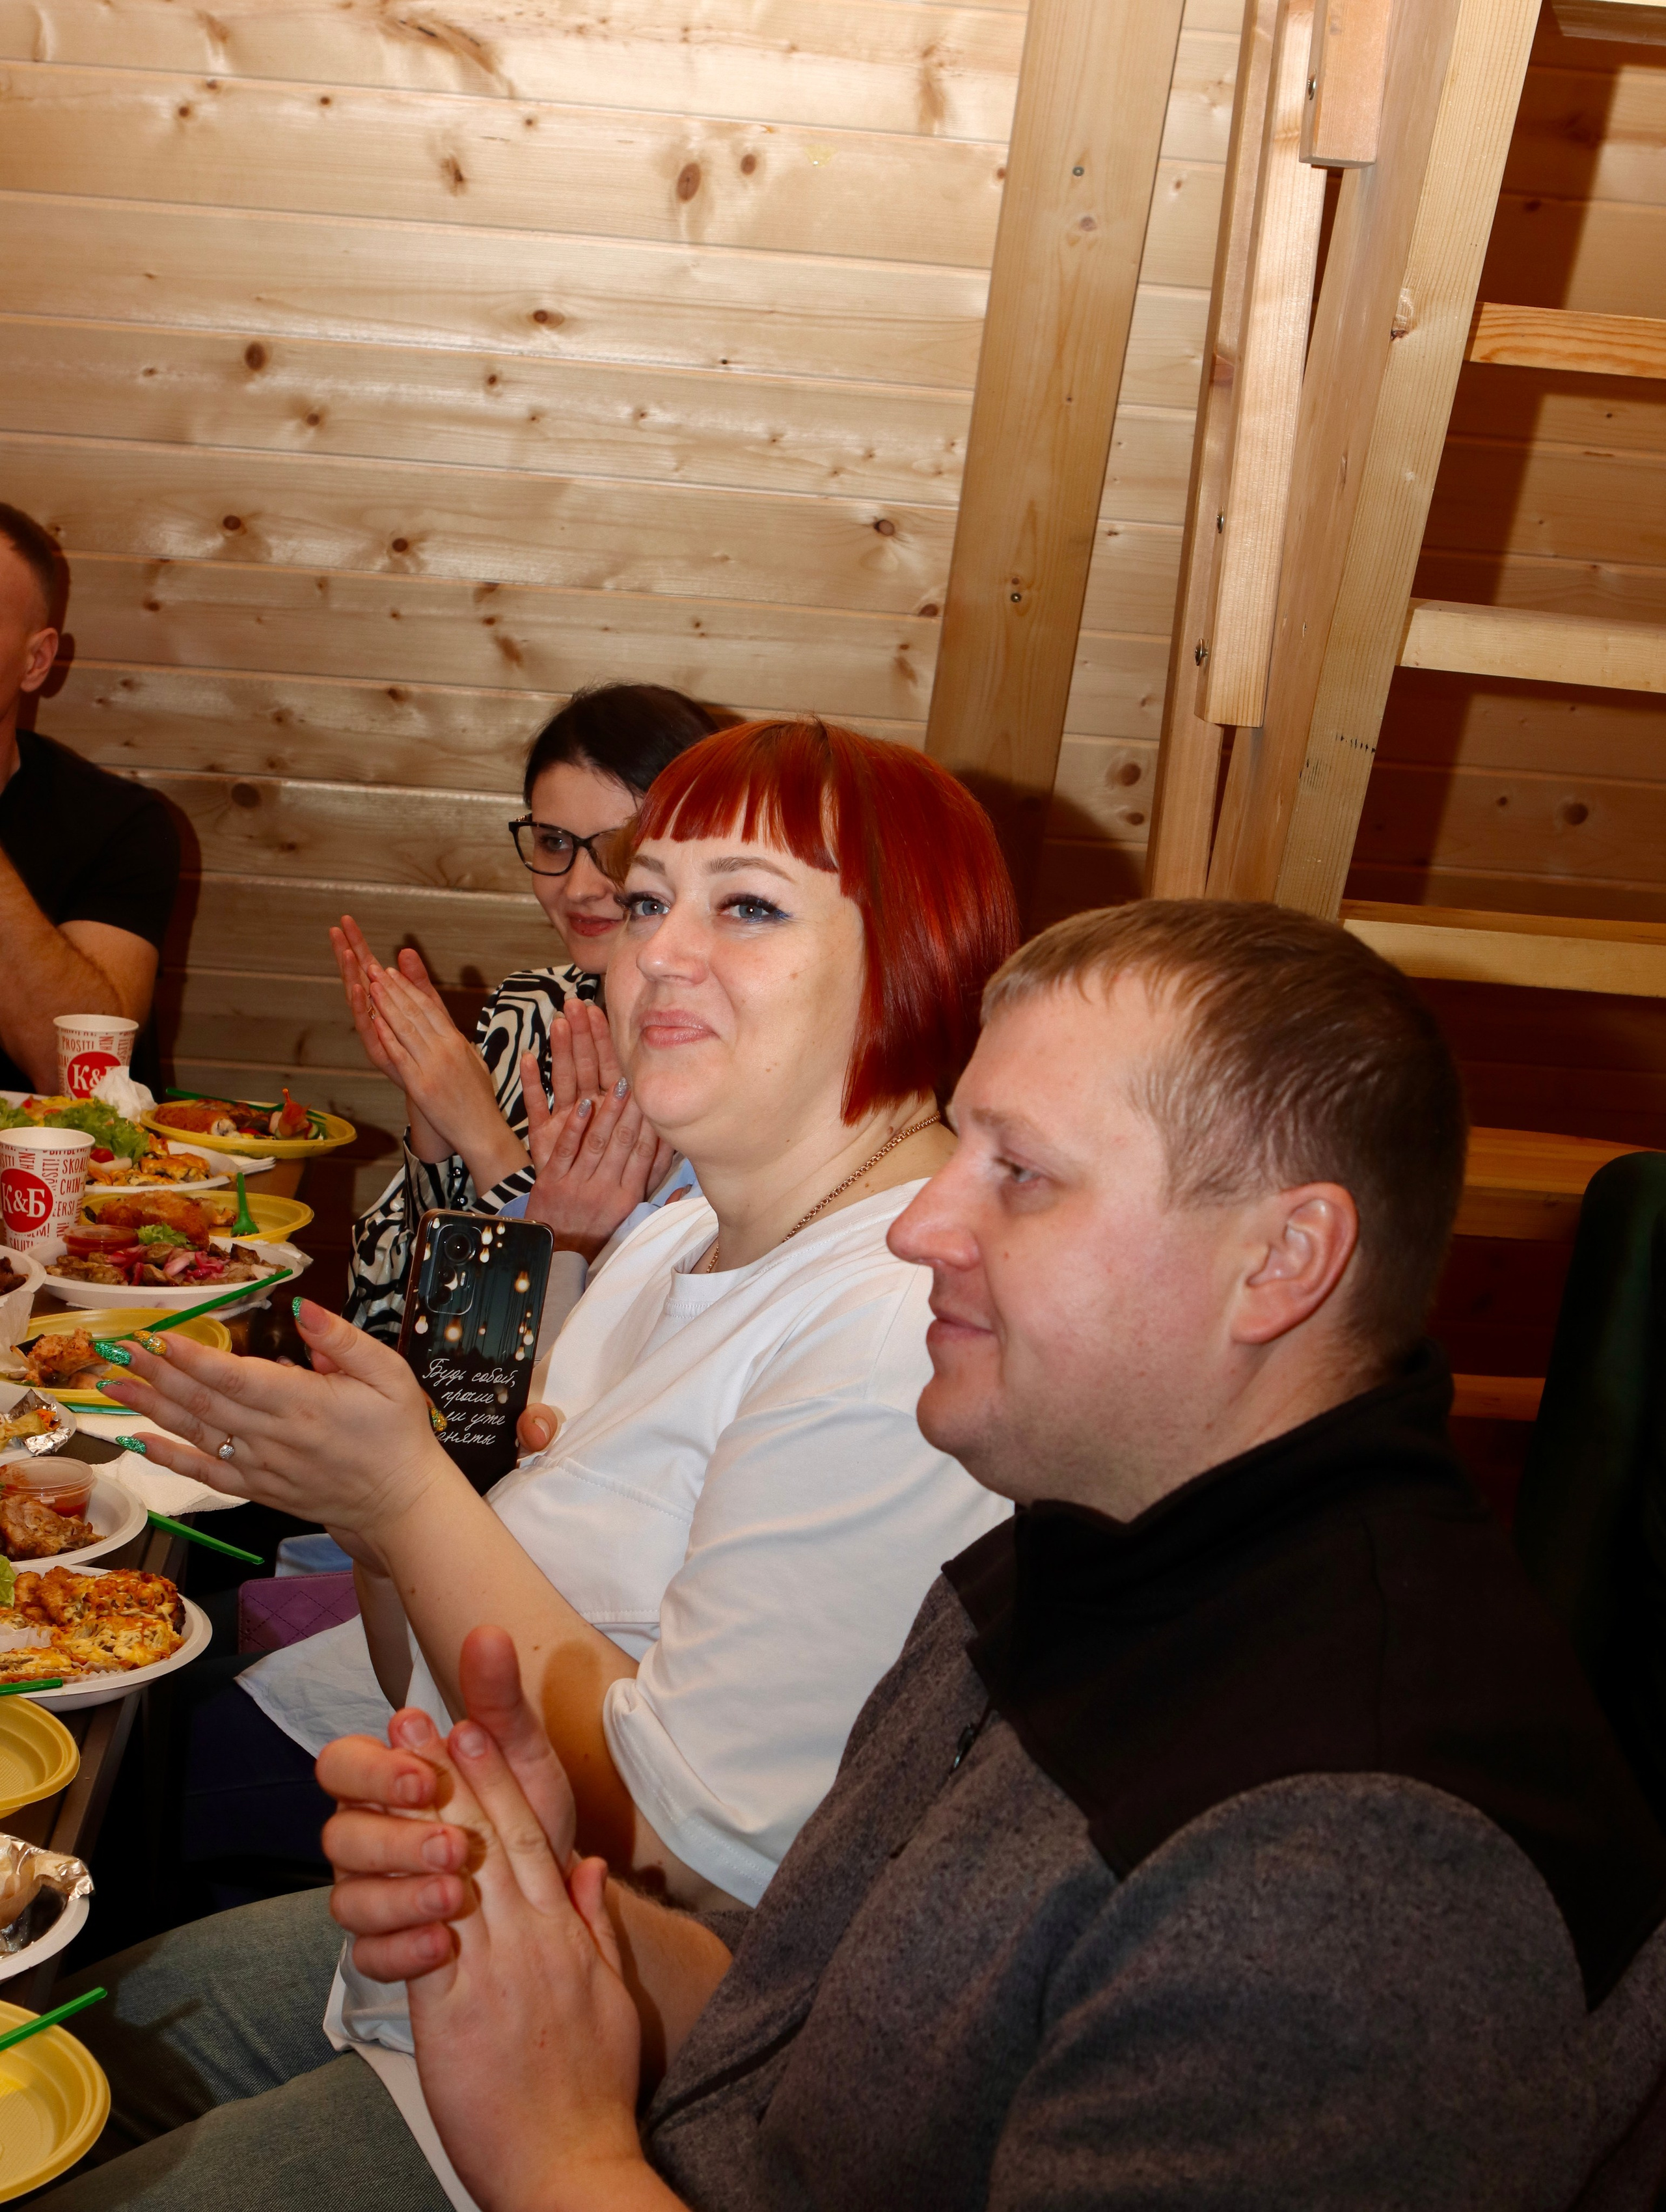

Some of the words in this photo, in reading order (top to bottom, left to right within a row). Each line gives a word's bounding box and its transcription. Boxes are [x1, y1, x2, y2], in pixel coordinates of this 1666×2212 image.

[422, 1358, 467, 1387] Будь
[471, 1367, 518, 1387] собой,
[441, 1388, 494, 1408] прочие
[464, 1413, 506, 1431] уже
[434, 1431, 496, 1445] аняты
